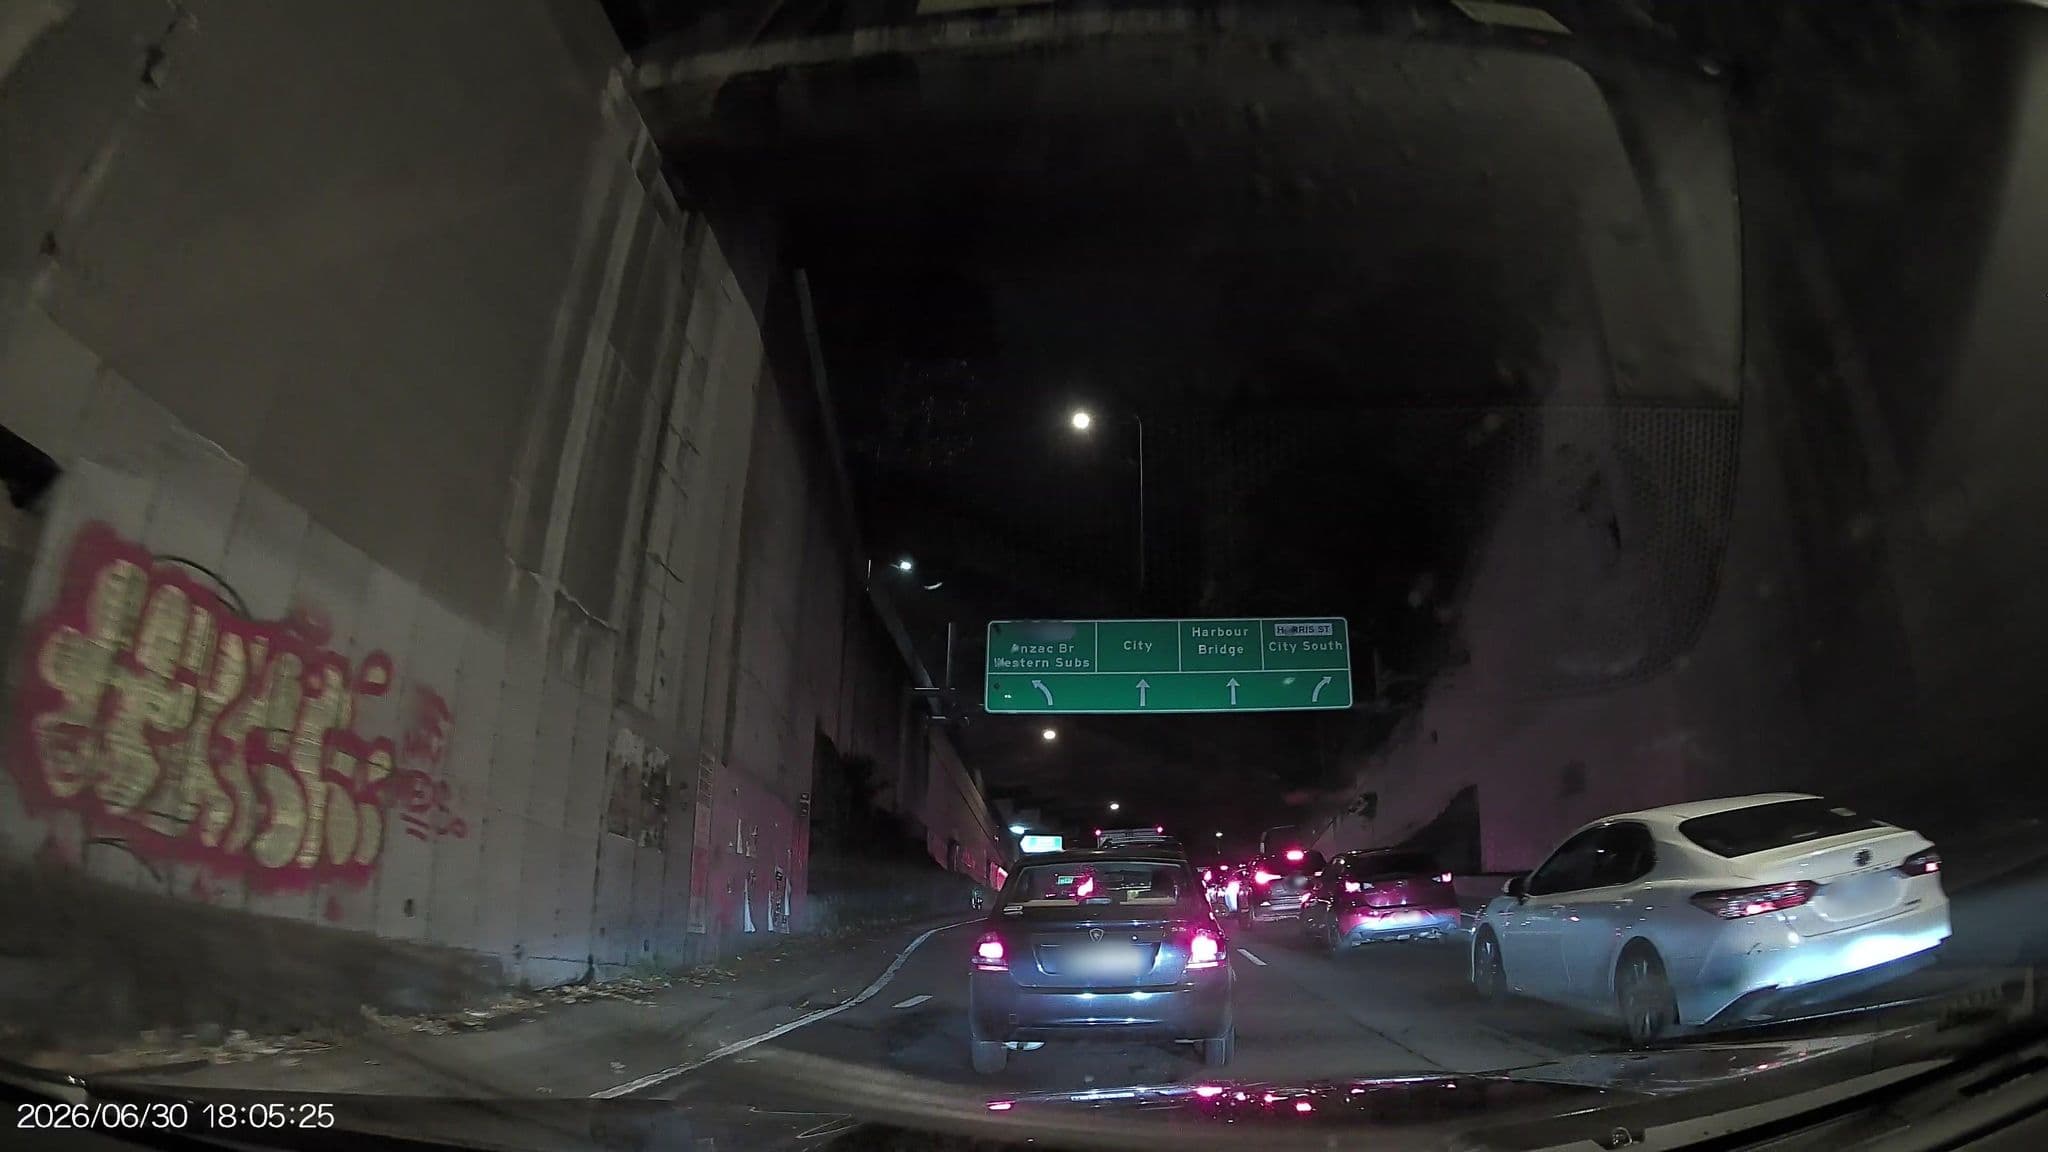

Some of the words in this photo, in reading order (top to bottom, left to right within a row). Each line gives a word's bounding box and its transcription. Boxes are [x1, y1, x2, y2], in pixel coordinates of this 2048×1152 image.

[1192, 626, 1249, 638] Harbour
[1277, 625, 1315, 634] HRRIS
[1318, 625, 1330, 633] ST
[1058, 643, 1075, 654] Br
[1123, 640, 1153, 653] City
[1198, 643, 1245, 657] Bridge
[1268, 641, 1297, 654] City
[1303, 641, 1343, 651] South
[1055, 657, 1091, 668] Subs
